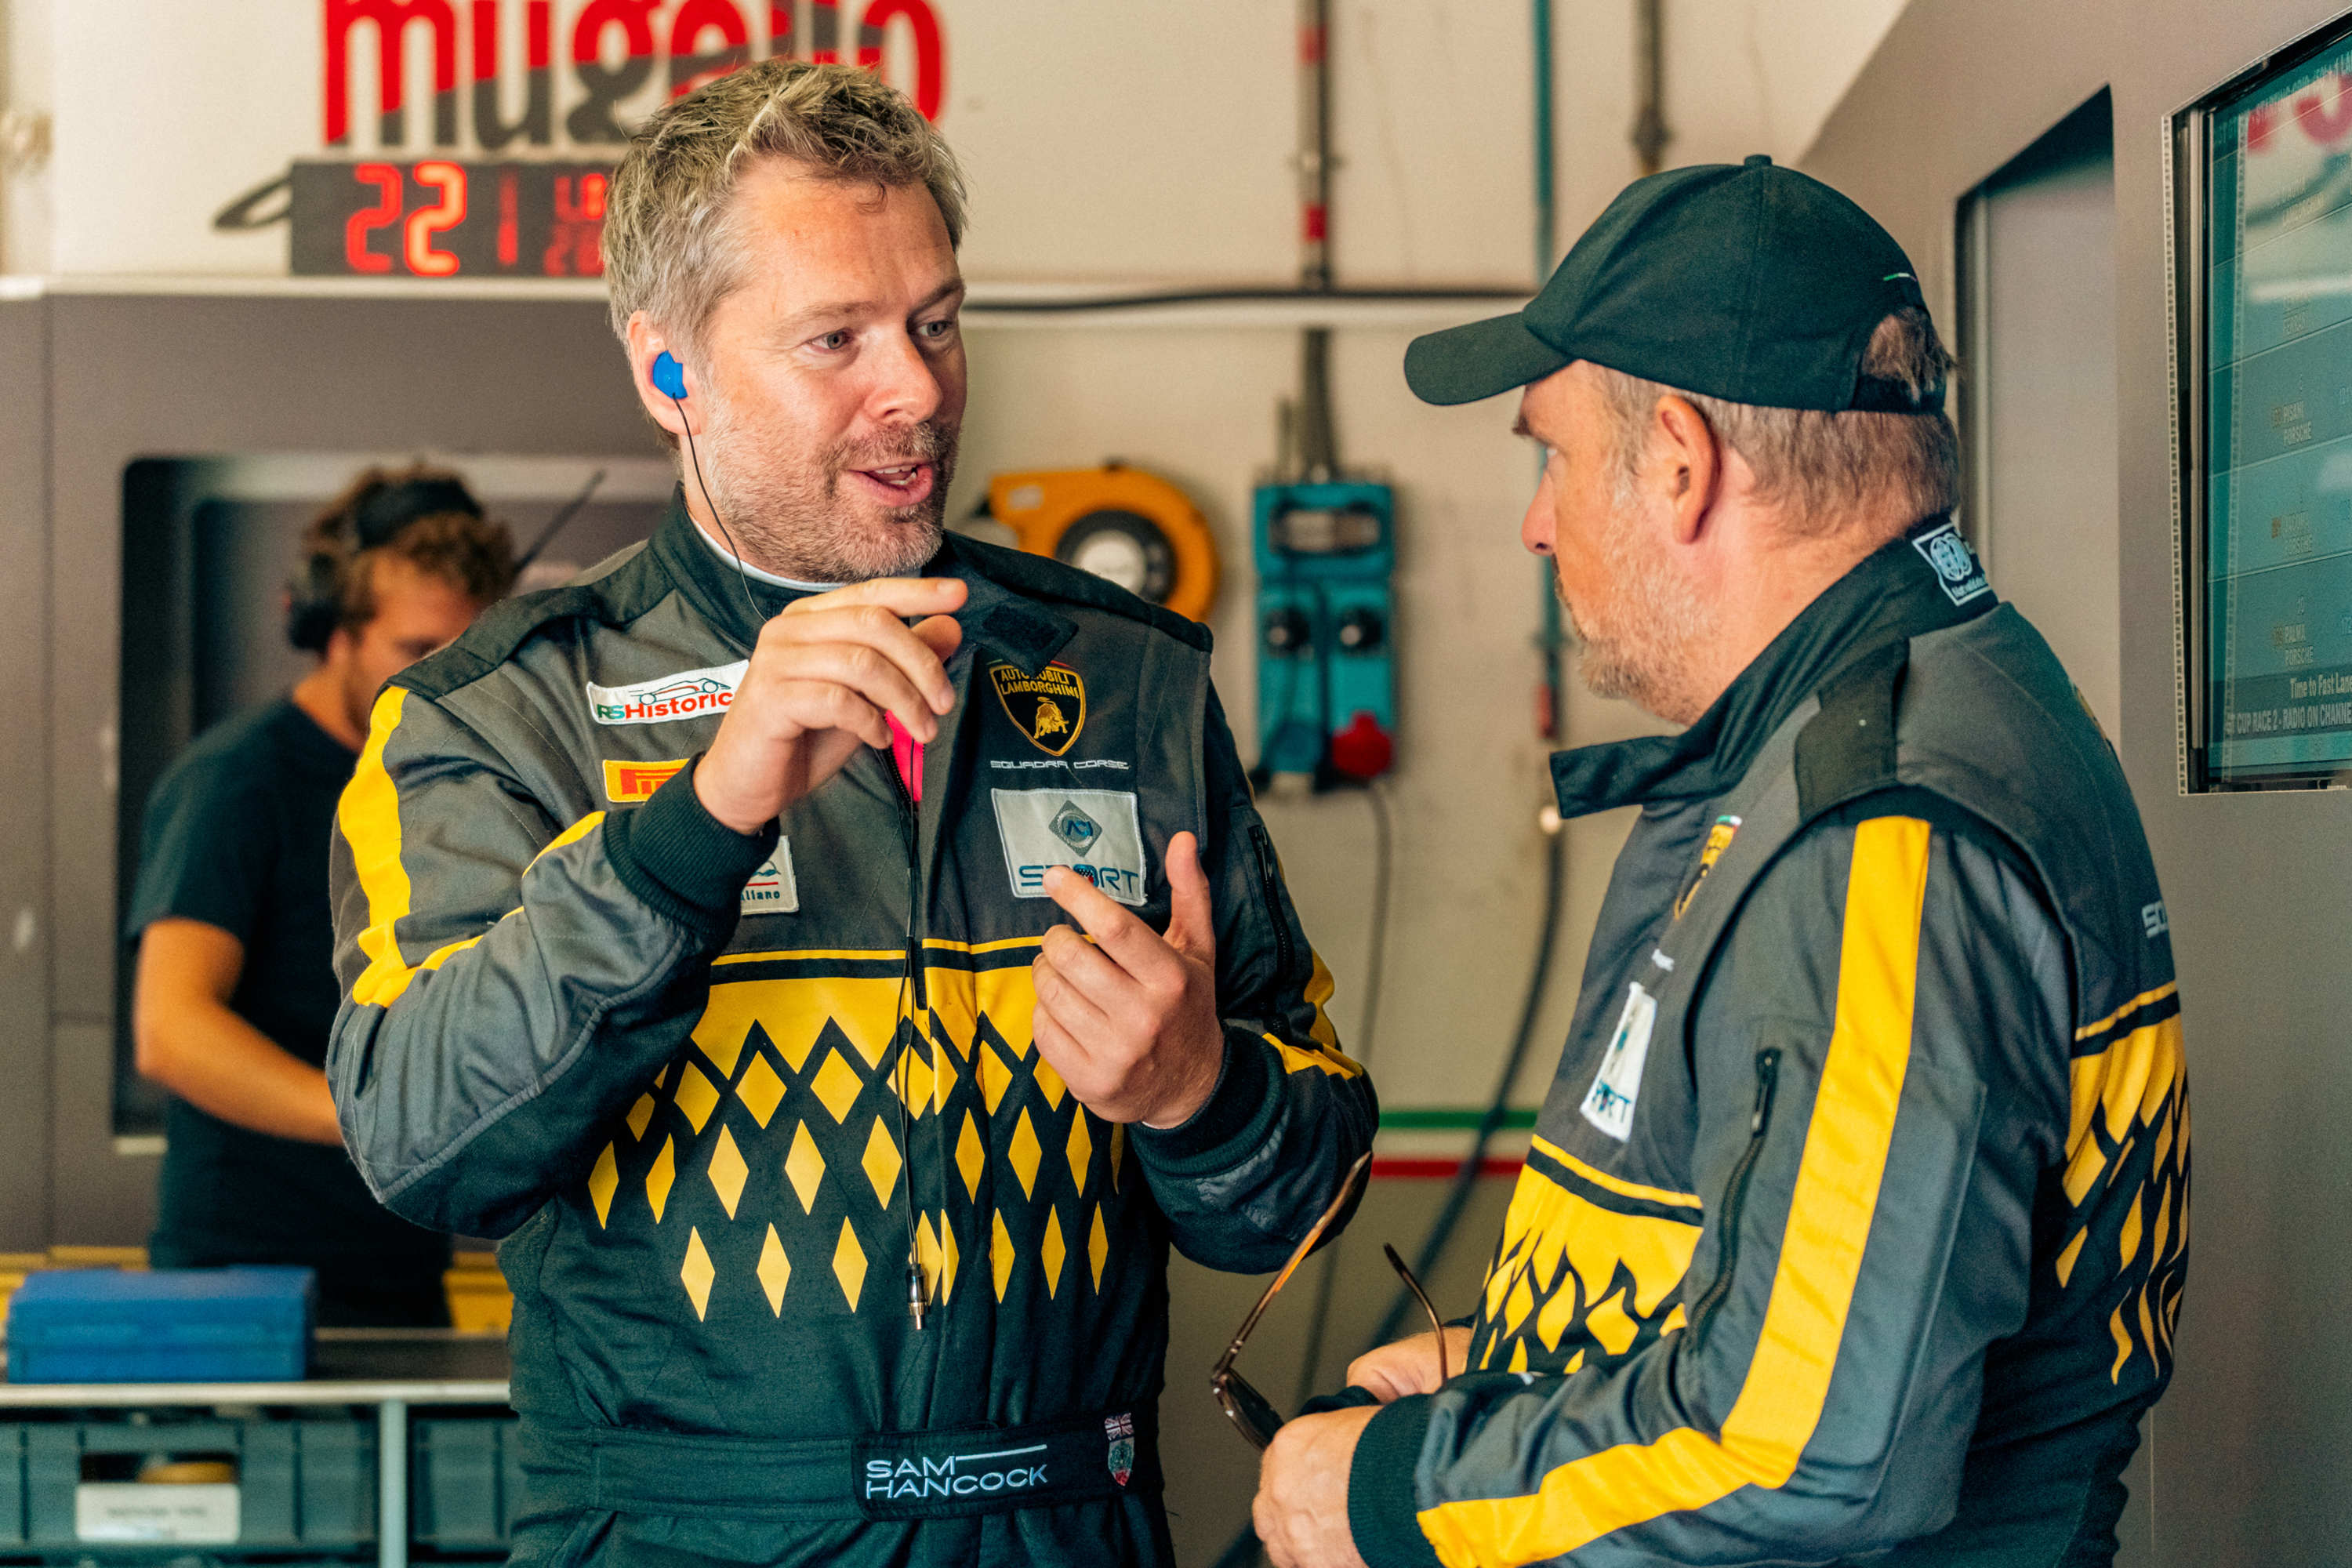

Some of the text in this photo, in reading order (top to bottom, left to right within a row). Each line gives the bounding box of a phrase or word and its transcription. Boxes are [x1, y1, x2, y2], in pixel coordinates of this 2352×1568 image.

[1000, 681, 1080, 699] LAMBORGHINI
[2290, 677, 2307, 699] Time
[2309, 676, 2317, 696] to
[2318, 673, 2334, 695] Fast
[2252, 710, 2271, 732] RACE
[2283, 706, 2305, 730] RADIO
[2307, 705, 2318, 728] ON
[2320, 702, 2352, 727] CHANNE
[990, 760, 1129, 770] SQUADRA CORSE
[1018, 864, 1139, 893] SORT
[866, 1455, 956, 1479] SAM
[866, 1464, 1048, 1499] HANCOCK
